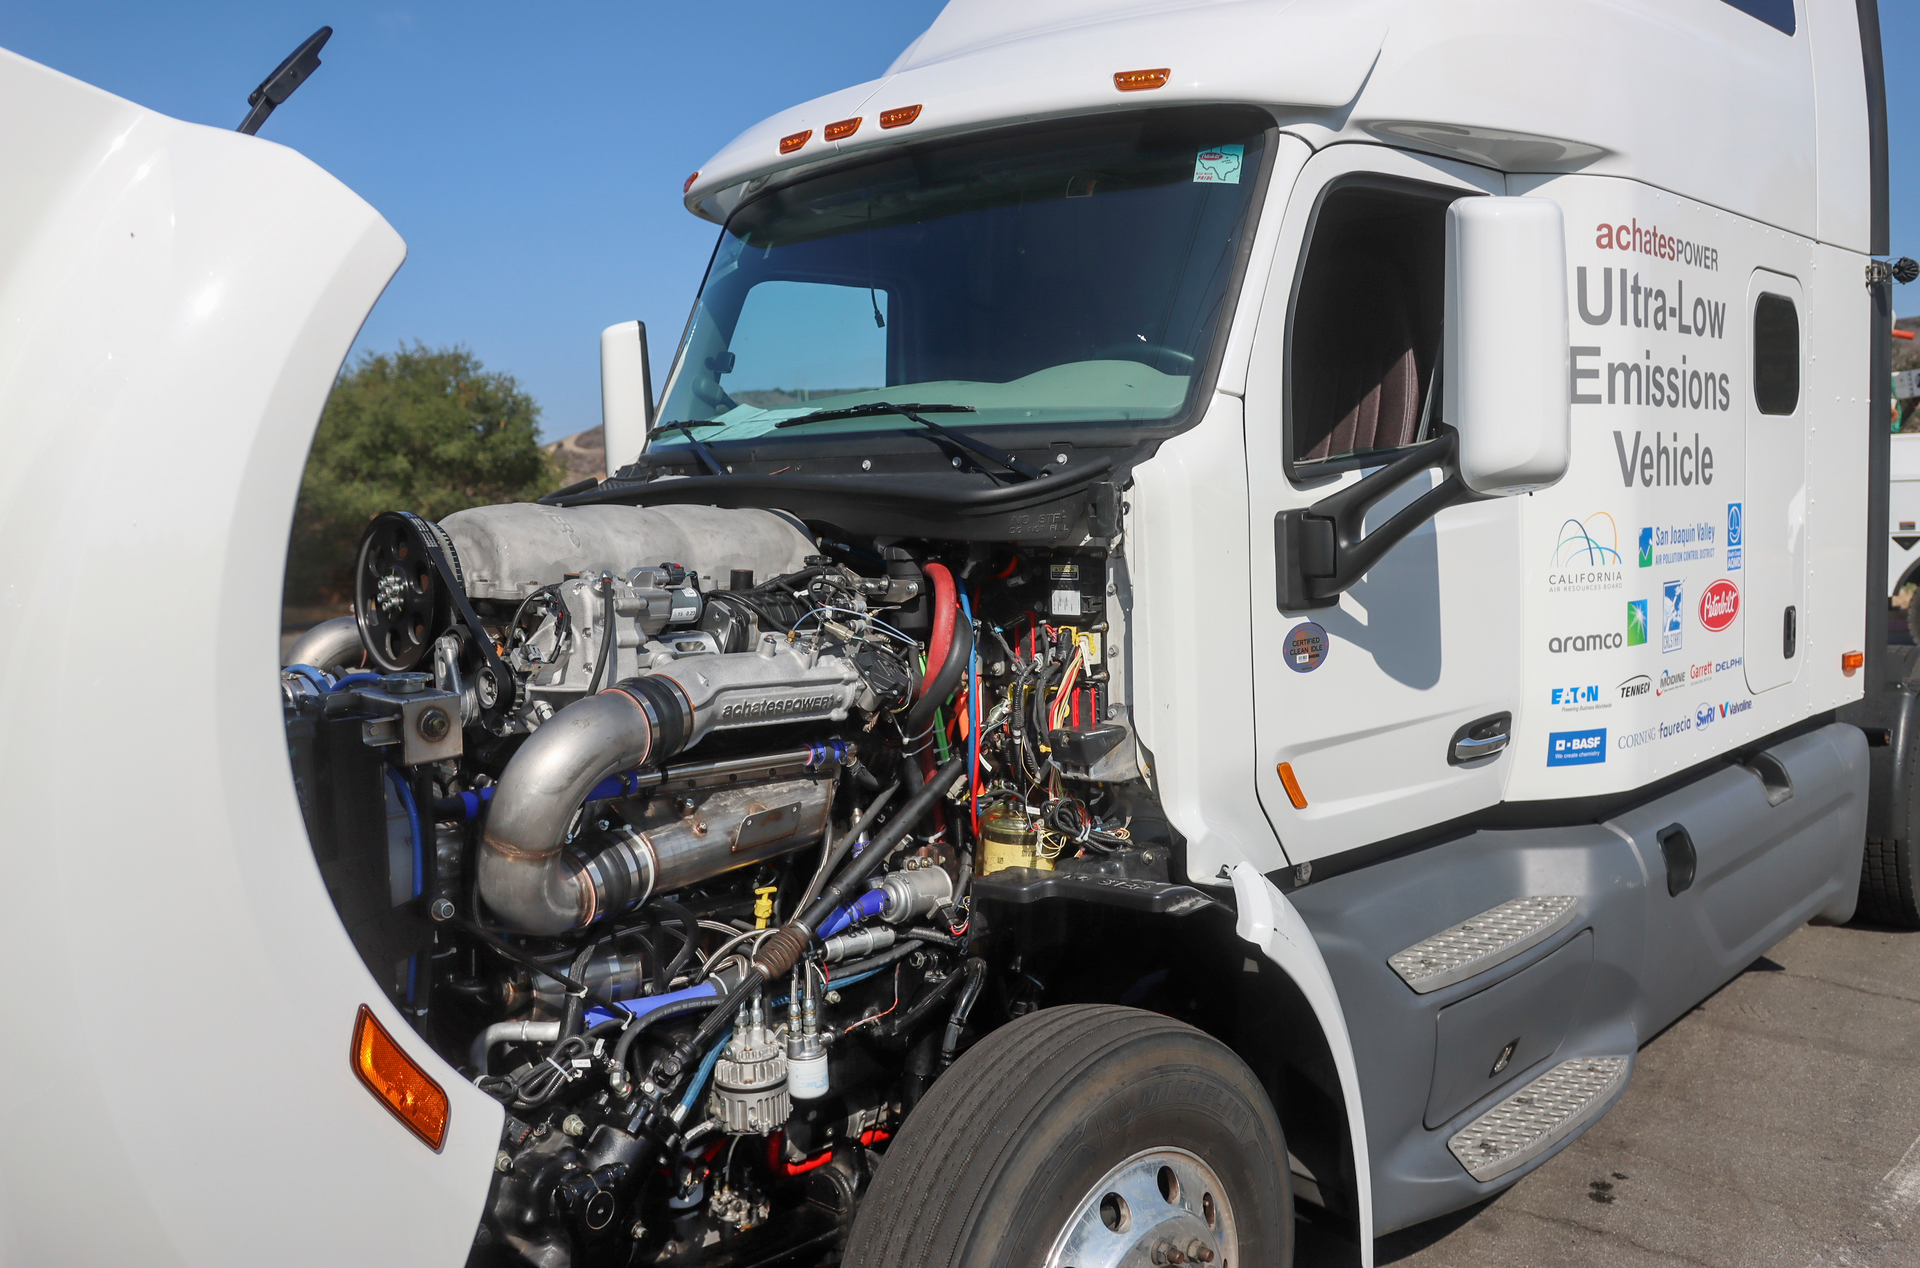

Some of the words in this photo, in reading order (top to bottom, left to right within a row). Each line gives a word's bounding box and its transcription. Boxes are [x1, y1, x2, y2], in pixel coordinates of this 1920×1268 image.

[1596, 217, 1719, 271] achatesPOWER
[1576, 266, 1726, 339] Ultra-Low
[1570, 346, 1730, 411] Emissions
[1613, 430, 1713, 487] Vehicle
[1012, 514, 1030, 525] NO
[1655, 527, 1669, 546] San
[1670, 524, 1695, 547] Joaquin
[1697, 522, 1715, 544] Valley
[1549, 571, 1622, 585] CALIFORNIA
[1549, 585, 1561, 593] AIR
[1563, 584, 1602, 592] RESOURCES
[1703, 590, 1738, 621] Peterbilt
[1290, 647, 1309, 656] CLEAN
[1292, 637, 1320, 647] CERTIFIED
[1548, 632, 1623, 653] aramco
[1690, 661, 1712, 679] Garrett
[1716, 657, 1742, 673] DELPHI
[1660, 672, 1686, 688] MODINE
[1551, 685, 1599, 705] EATON
[722, 696, 829, 718] achatesPOWER
[1696, 706, 1715, 727] SwRI
[1729, 699, 1752, 715] Valvoline
[1659, 715, 1691, 739] faurecia
[1572, 736, 1601, 750] BASF
[1618, 727, 1656, 750] CORNING
[1141, 1079, 1246, 1128] MICHELIN
